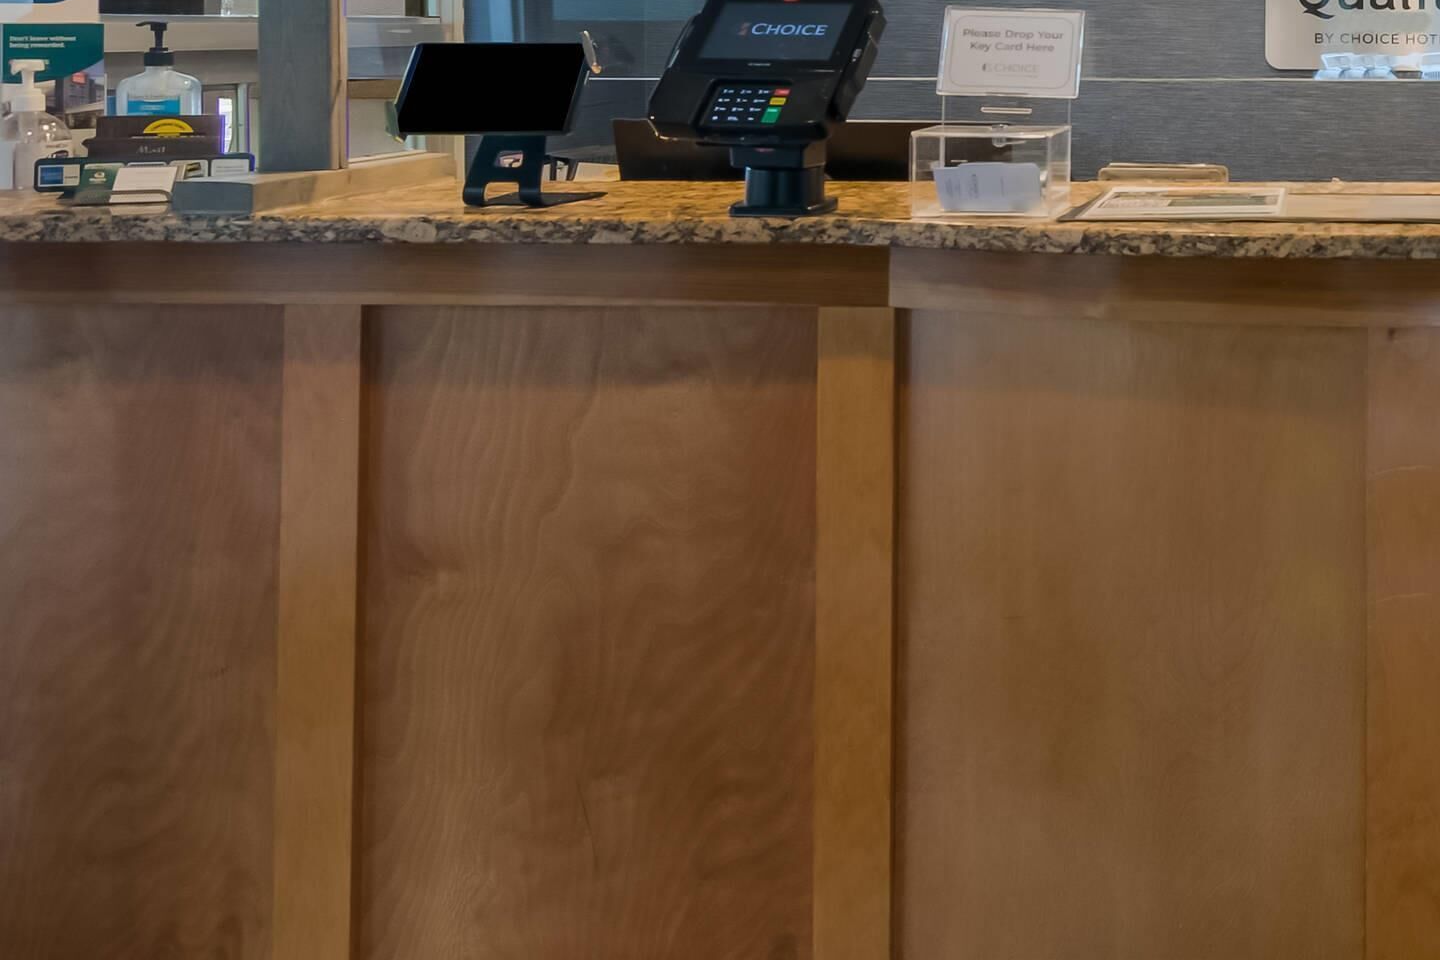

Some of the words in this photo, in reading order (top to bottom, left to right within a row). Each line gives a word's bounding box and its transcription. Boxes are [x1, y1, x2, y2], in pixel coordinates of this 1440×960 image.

[751, 22, 829, 37] CHOICE
[962, 28, 1001, 38] Please
[1005, 29, 1034, 40] Drop
[1038, 31, 1064, 40] Your
[1314, 32, 1334, 44] BY
[1339, 32, 1400, 45] CHOICE
[969, 41, 992, 52] Key
[994, 42, 1023, 51] Card
[1026, 43, 1055, 52] Here
